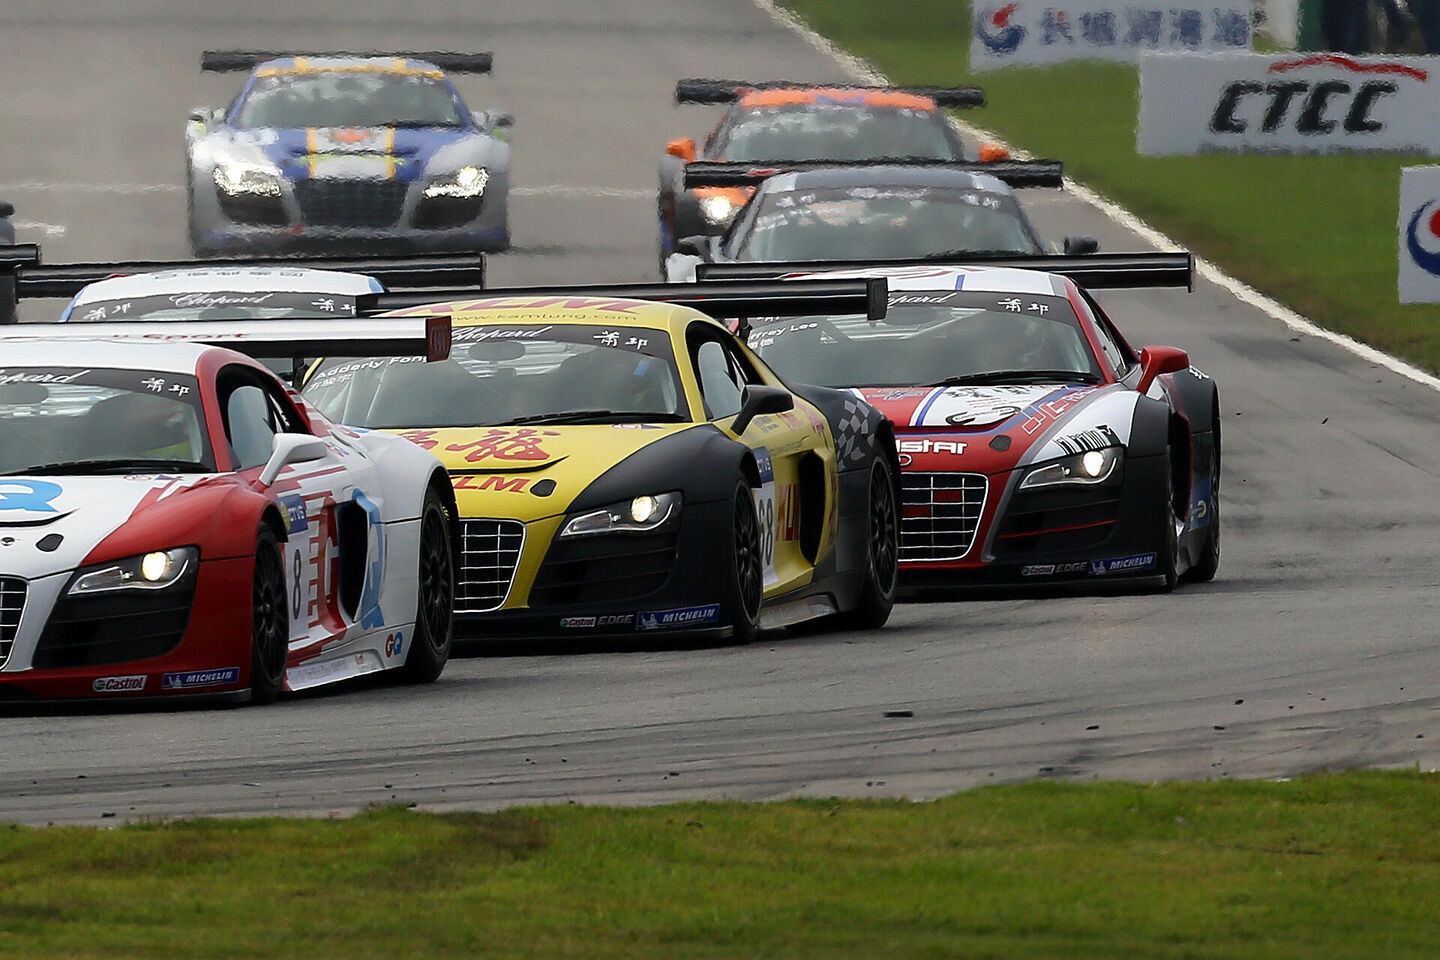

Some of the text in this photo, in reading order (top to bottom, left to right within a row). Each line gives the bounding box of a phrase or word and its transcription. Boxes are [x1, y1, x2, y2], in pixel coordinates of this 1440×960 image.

[1209, 80, 1400, 135] CTCC
[452, 311, 638, 323] ww.kamlung.com
[313, 358, 385, 381] Adderly
[1057, 562, 1088, 573] EDGE
[1109, 555, 1154, 570] MICHELIN
[293, 548, 302, 620] 8
[597, 614, 635, 625] EDGE
[662, 608, 716, 623] MICHELIN
[385, 631, 403, 658] GQ
[105, 677, 143, 690] Castrol
[185, 670, 234, 683] MICHELIN
